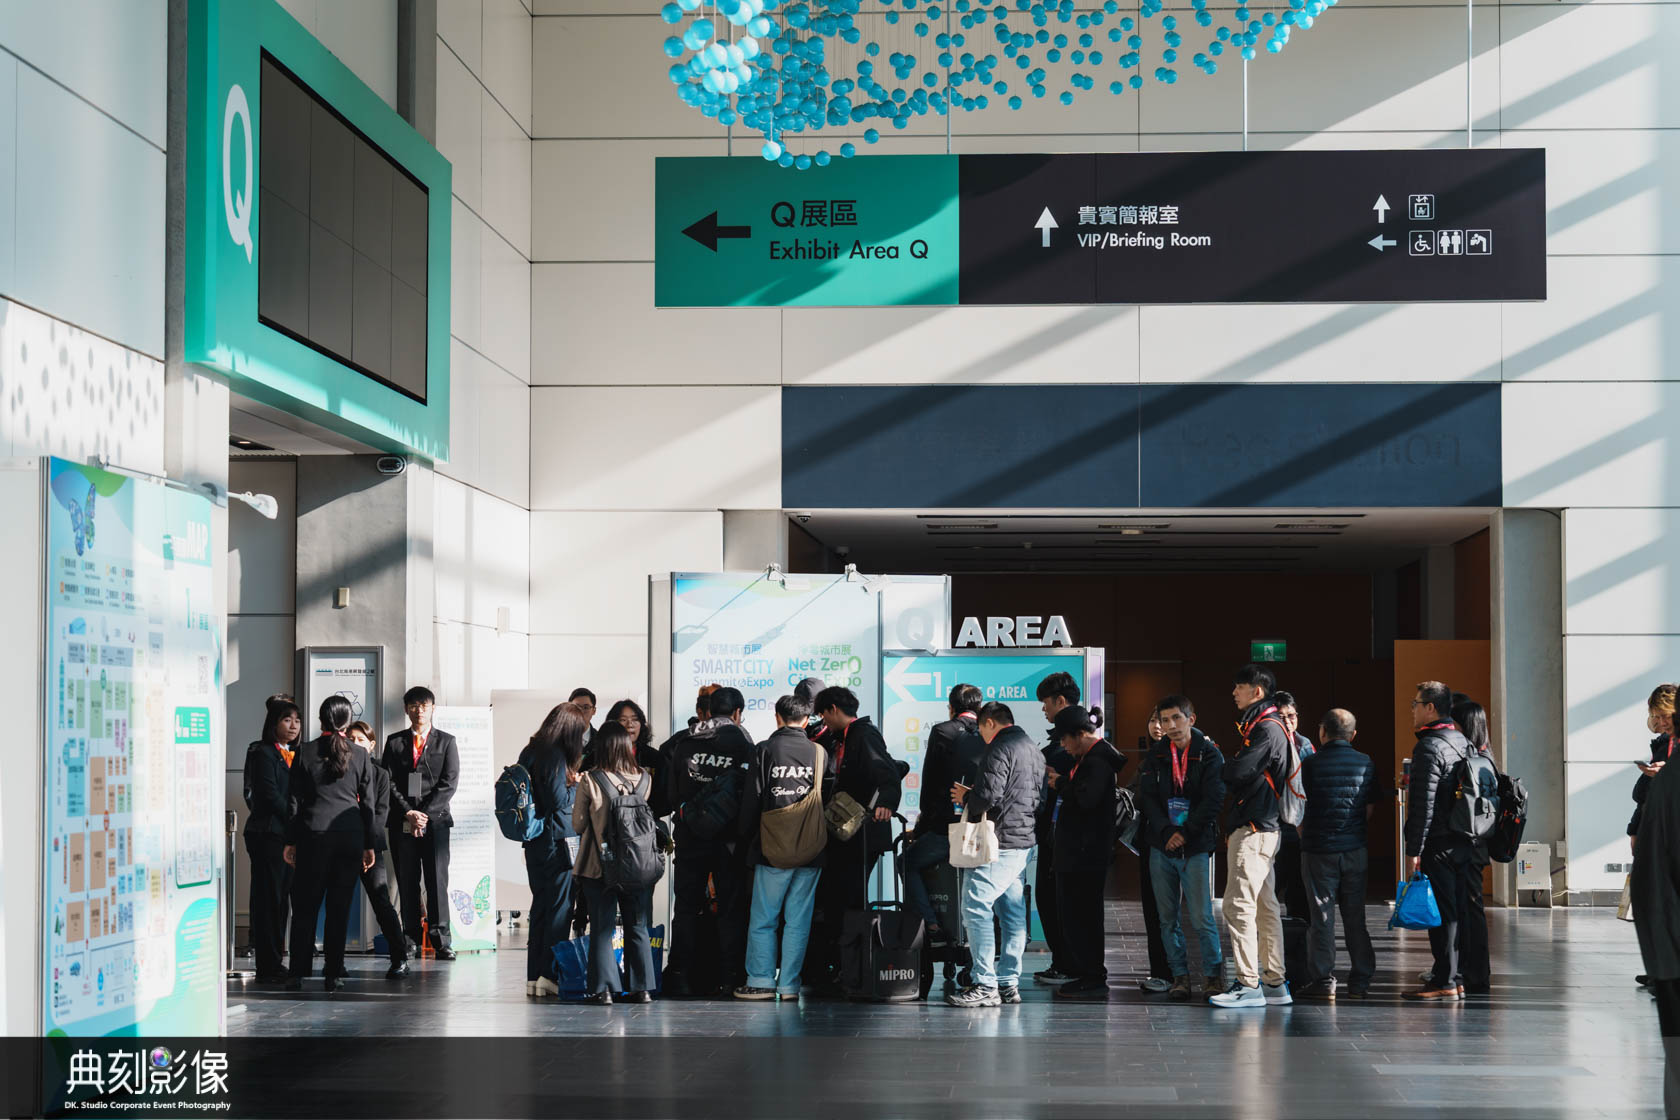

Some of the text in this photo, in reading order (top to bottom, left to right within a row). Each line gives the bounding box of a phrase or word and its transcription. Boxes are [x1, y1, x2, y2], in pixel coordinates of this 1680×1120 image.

[223, 84, 253, 264] Q
[770, 199, 858, 228] Q展區
[1078, 205, 1179, 225] 貴賓簡報室
[1077, 232, 1211, 249] VIP/Briefing Room
[770, 239, 929, 260] Exhibit Area Q
[897, 607, 1073, 656] Q AREA
[788, 657, 816, 671] Net
[986, 686, 996, 698] Q
[998, 686, 1028, 699] AREA
[691, 753, 733, 768] STAFF
[771, 765, 813, 778] STAFF
[879, 968, 915, 981] MIPRO
